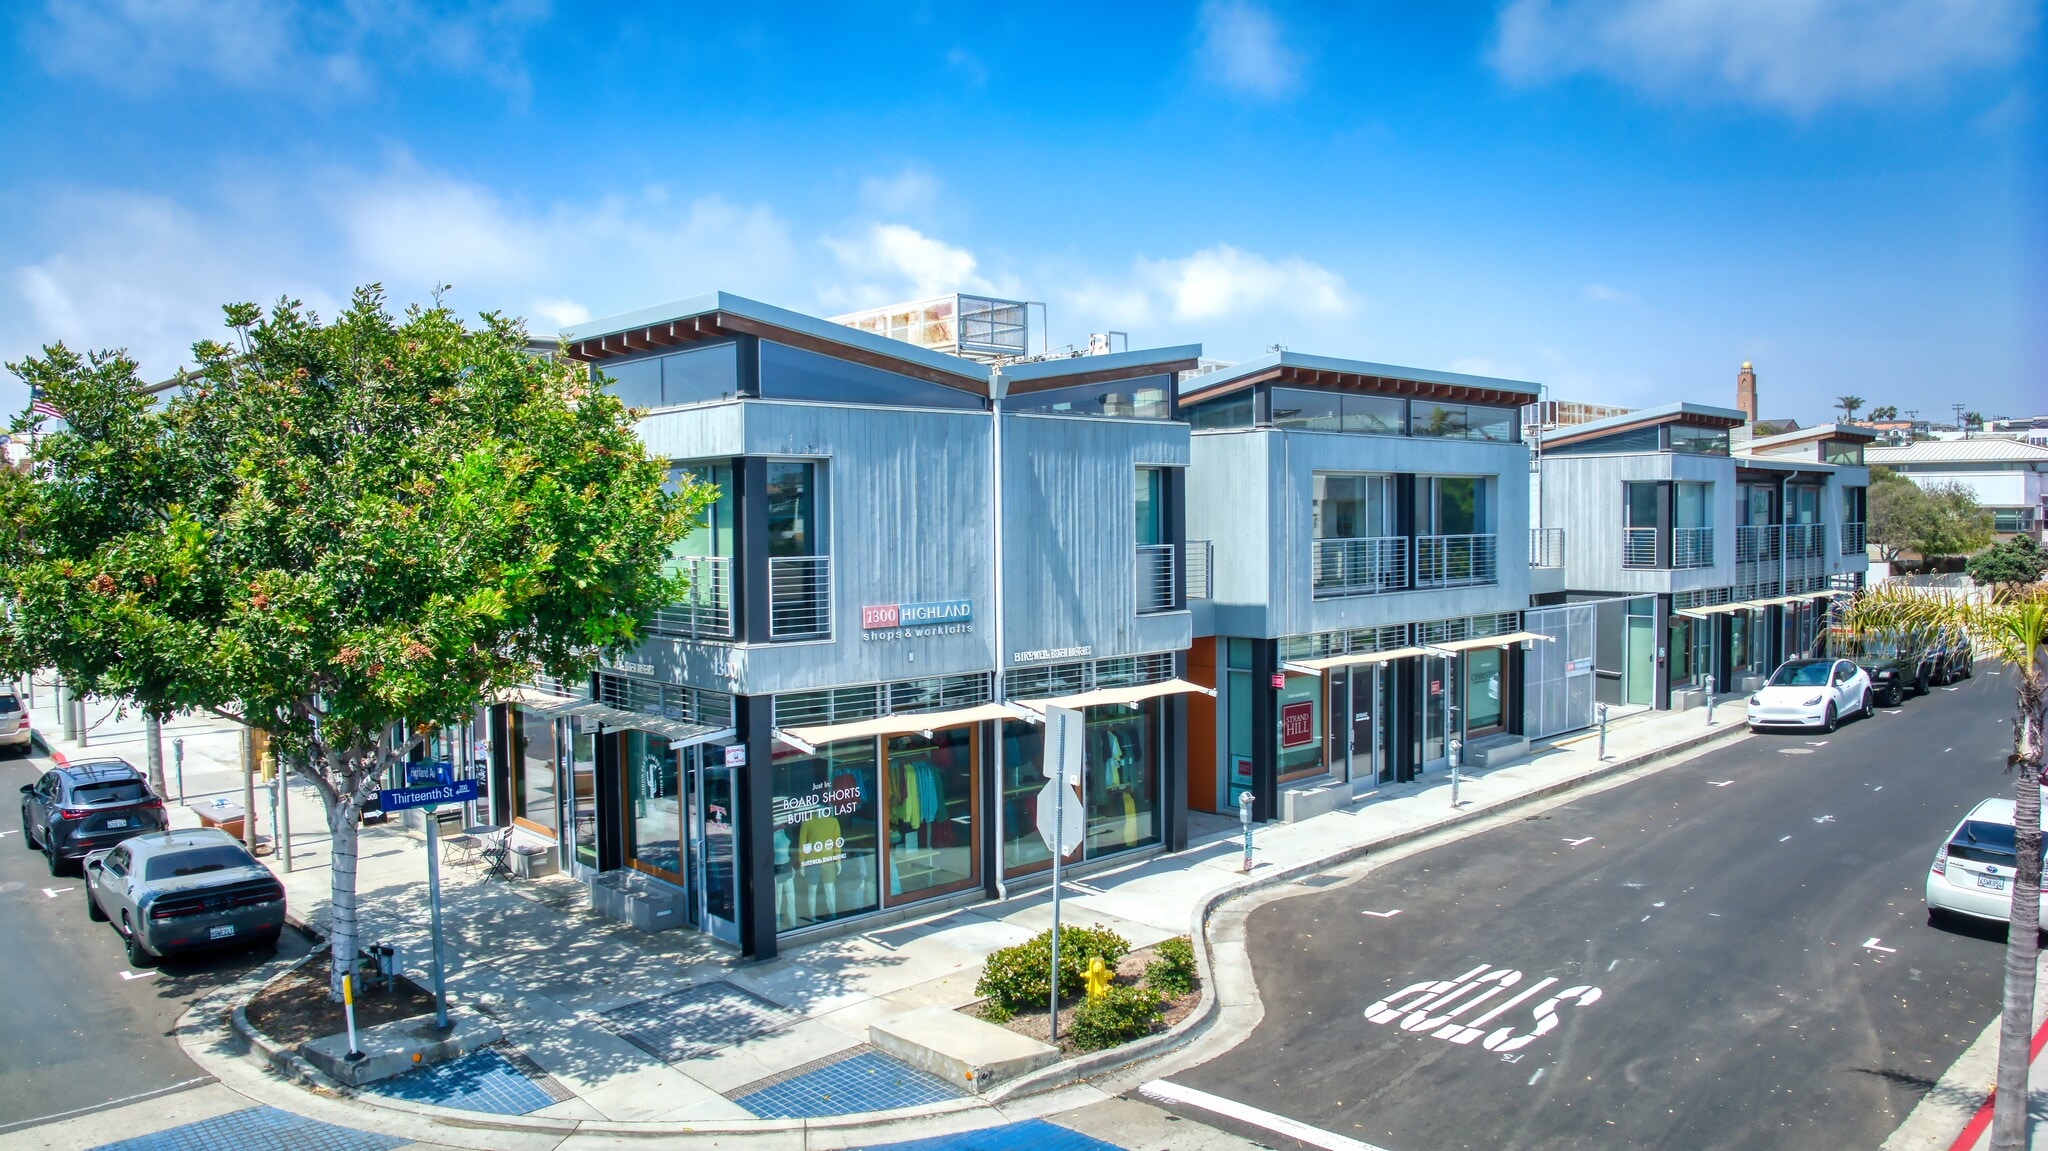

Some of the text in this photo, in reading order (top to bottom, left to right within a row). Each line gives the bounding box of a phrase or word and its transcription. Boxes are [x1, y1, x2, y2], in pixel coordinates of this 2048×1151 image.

[866, 604, 970, 624] 1300 HIGHLAND
[863, 624, 974, 641] shops & worklofts
[713, 661, 737, 678] 1300
[1286, 713, 1309, 723] STRAND
[1286, 721, 1309, 736] HILL
[410, 766, 430, 779] Highland
[812, 782, 823, 790] Just
[392, 789, 442, 805] Thirteenth
[443, 786, 453, 799] St
[783, 786, 860, 810] BOARD SHORTS
[788, 802, 857, 824] BUILT TO LAST
[1364, 963, 1603, 1052] STOP
